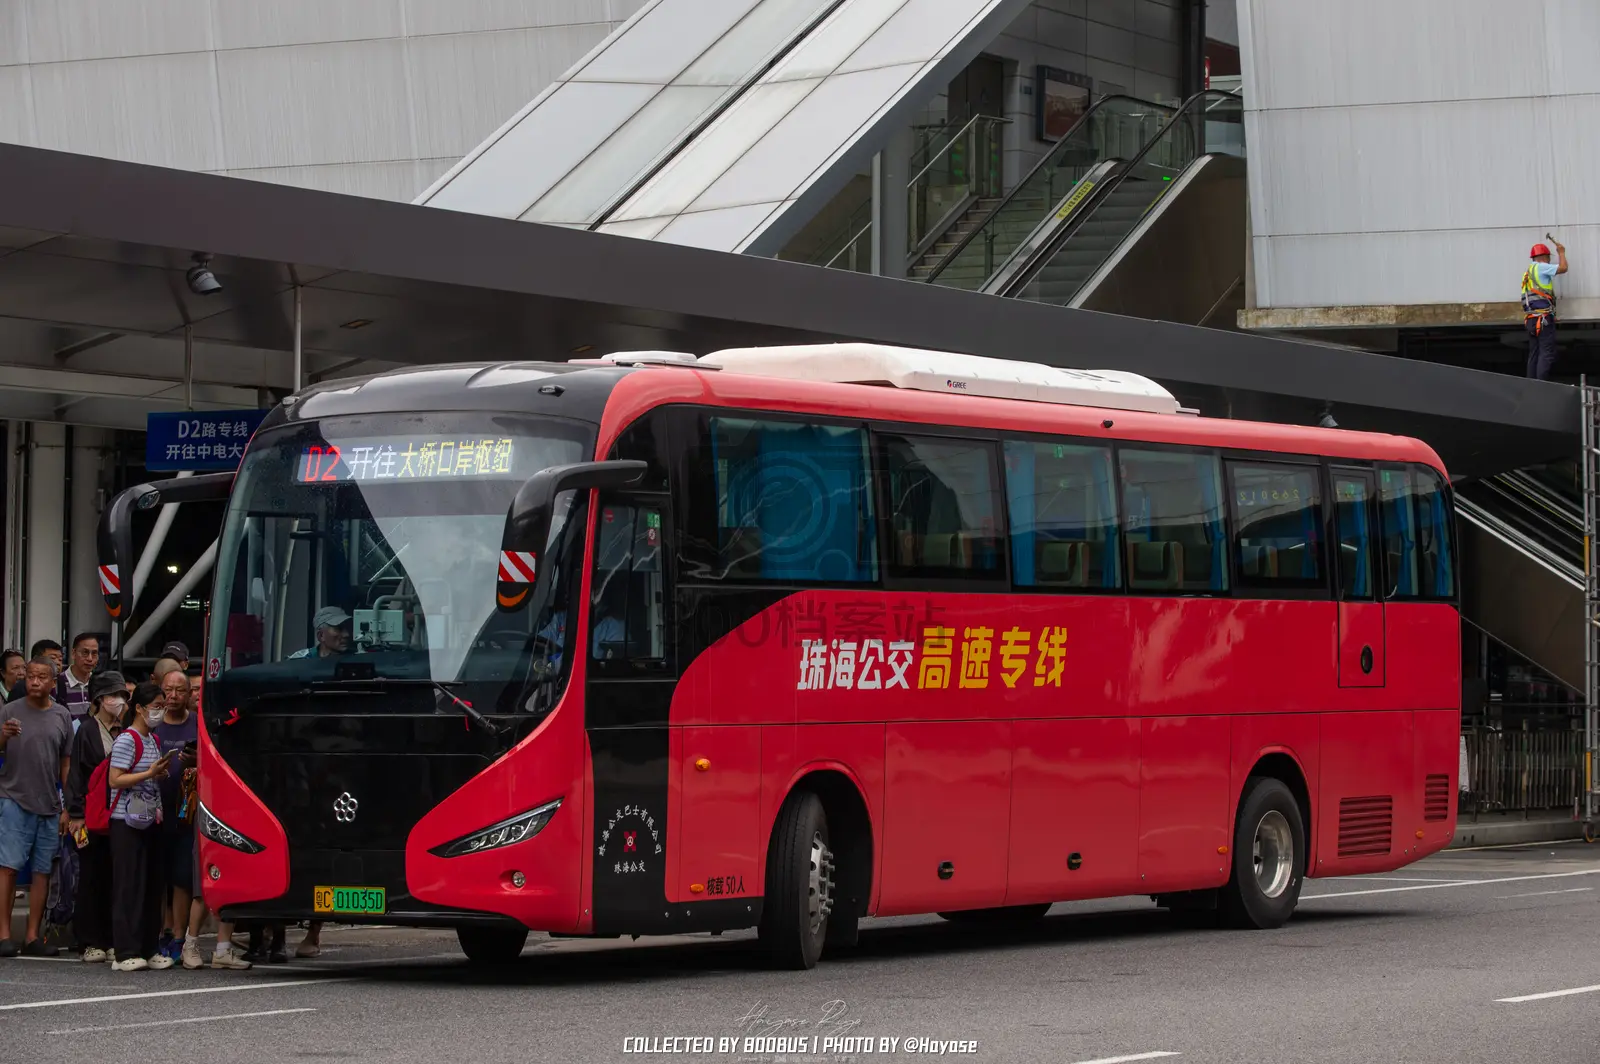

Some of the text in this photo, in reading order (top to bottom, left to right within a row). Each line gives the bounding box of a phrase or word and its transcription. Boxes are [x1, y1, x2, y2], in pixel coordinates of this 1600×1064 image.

[953, 381, 966, 389] GREE
[178, 420, 248, 438] D2路专线
[166, 442, 248, 460] 开往中电大
[305, 445, 341, 482] D2
[614, 860, 646, 874] 珠海公交
